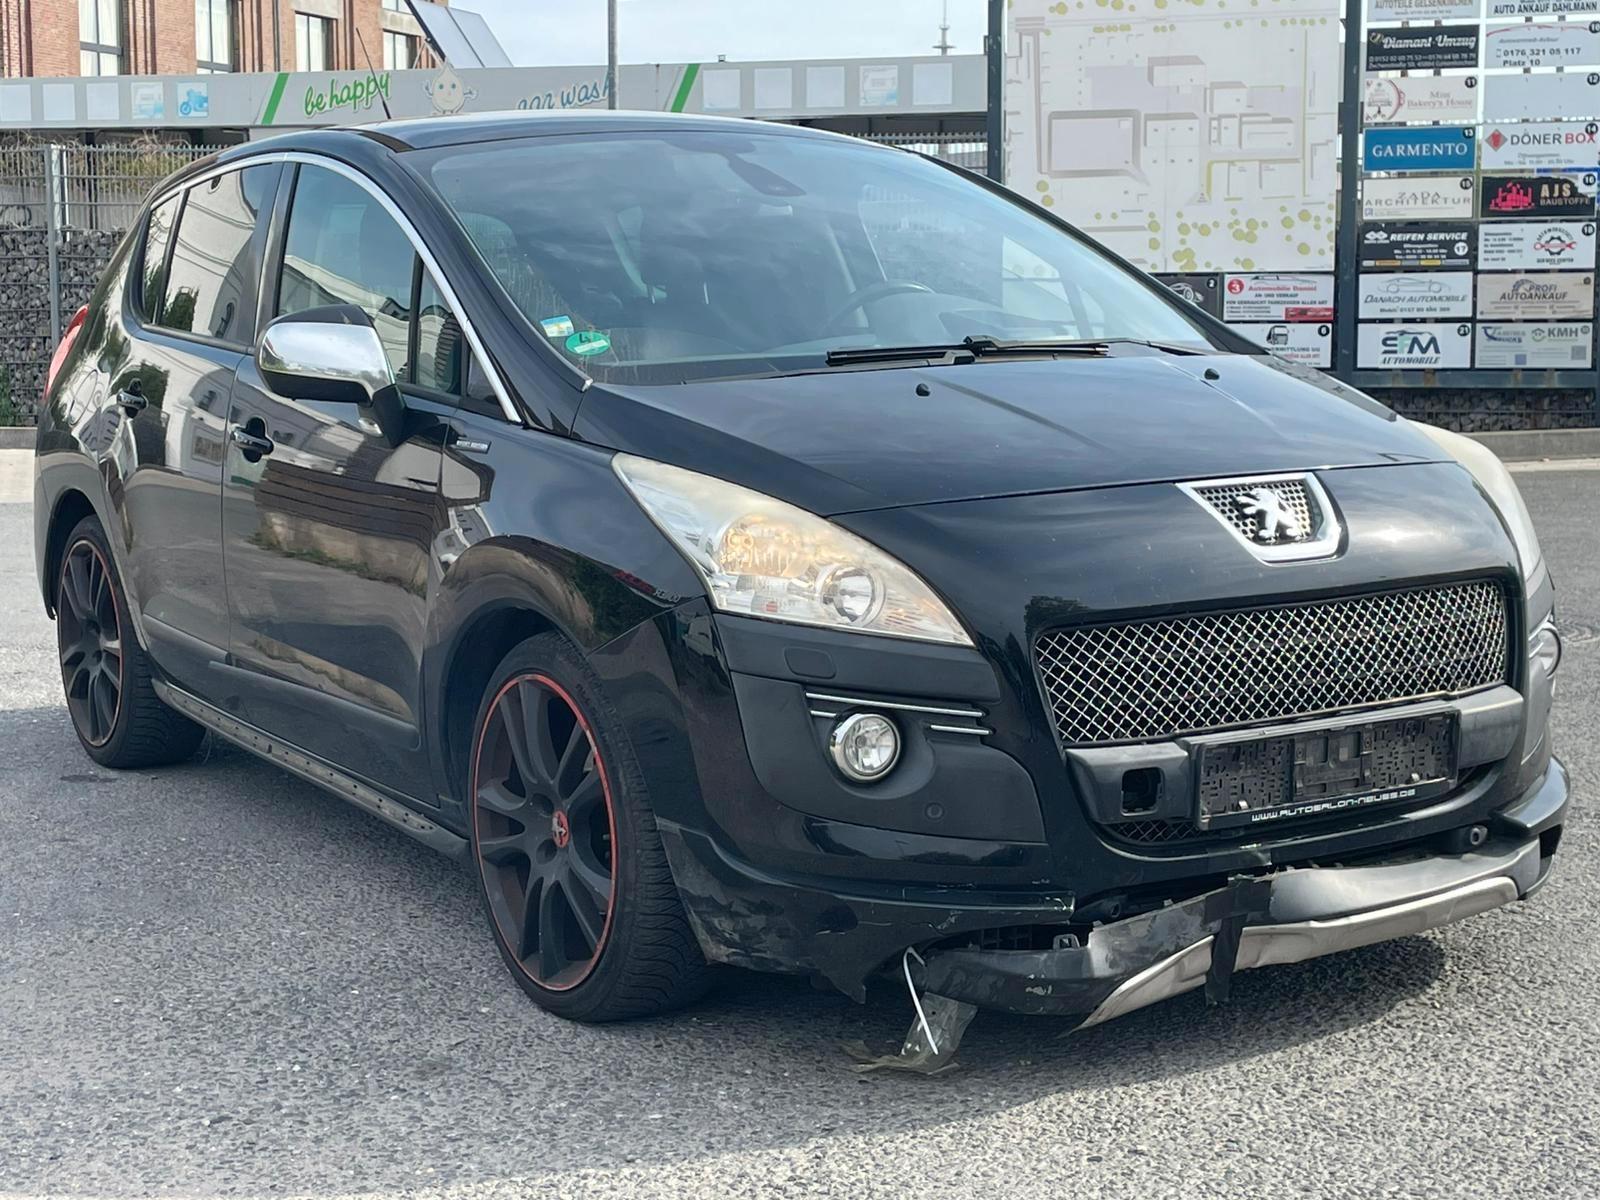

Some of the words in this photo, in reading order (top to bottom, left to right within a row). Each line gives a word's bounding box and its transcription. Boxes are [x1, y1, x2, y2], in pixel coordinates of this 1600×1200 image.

[1494, 5, 1515, 14] AUTO
[1518, 3, 1550, 13] ANKAUF
[1552, 2, 1598, 12] DAHLMANN
[1383, 36, 1432, 49] Diamant
[1434, 34, 1476, 49] Umzug
[1503, 49, 1526, 57] 0176
[1529, 48, 1546, 56] 321
[1564, 47, 1581, 55] 117
[305, 86, 326, 115] be
[329, 71, 389, 111] happy
[1511, 131, 1562, 145] DÖNER
[1565, 133, 1595, 144] BOX
[1372, 143, 1468, 157] GARMENTO
[1365, 197, 1471, 207] ARCHITEKTUR
[1540, 197, 1590, 206] BAUSTOFFE
[1390, 233, 1425, 241] REIFEN
[1427, 232, 1468, 240] SERVICE
[1456, 245, 1466, 253] 17
[1231, 280, 1240, 292] 3
[1528, 284, 1557, 293] PROFI
[1499, 292, 1568, 301] AUTOANKAUF
[1548, 328, 1578, 337] KMH
[1381, 357, 1440, 365] AUTOMOBILE
